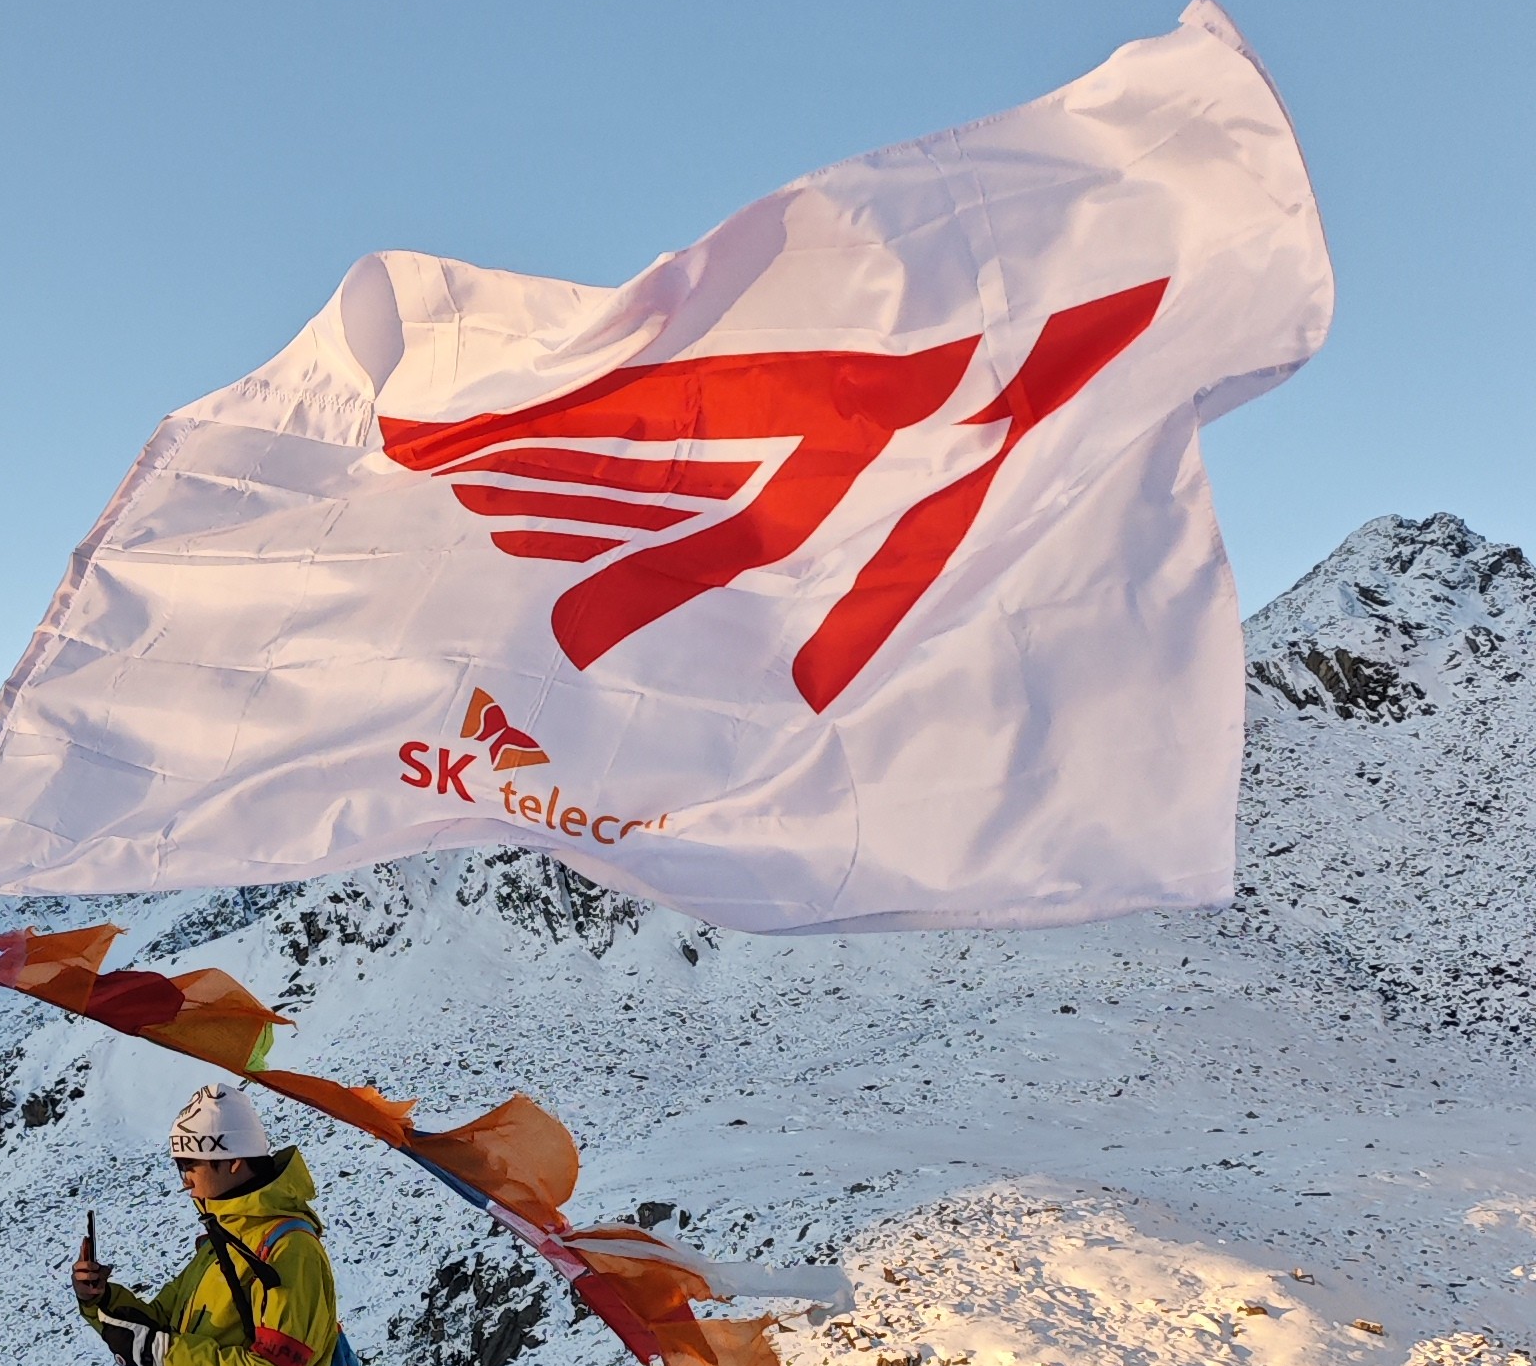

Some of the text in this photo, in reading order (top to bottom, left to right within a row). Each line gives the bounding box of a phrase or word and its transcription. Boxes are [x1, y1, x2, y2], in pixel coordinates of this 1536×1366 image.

[398, 740, 668, 845] SK telec
[169, 1133, 229, 1153] ERYX
